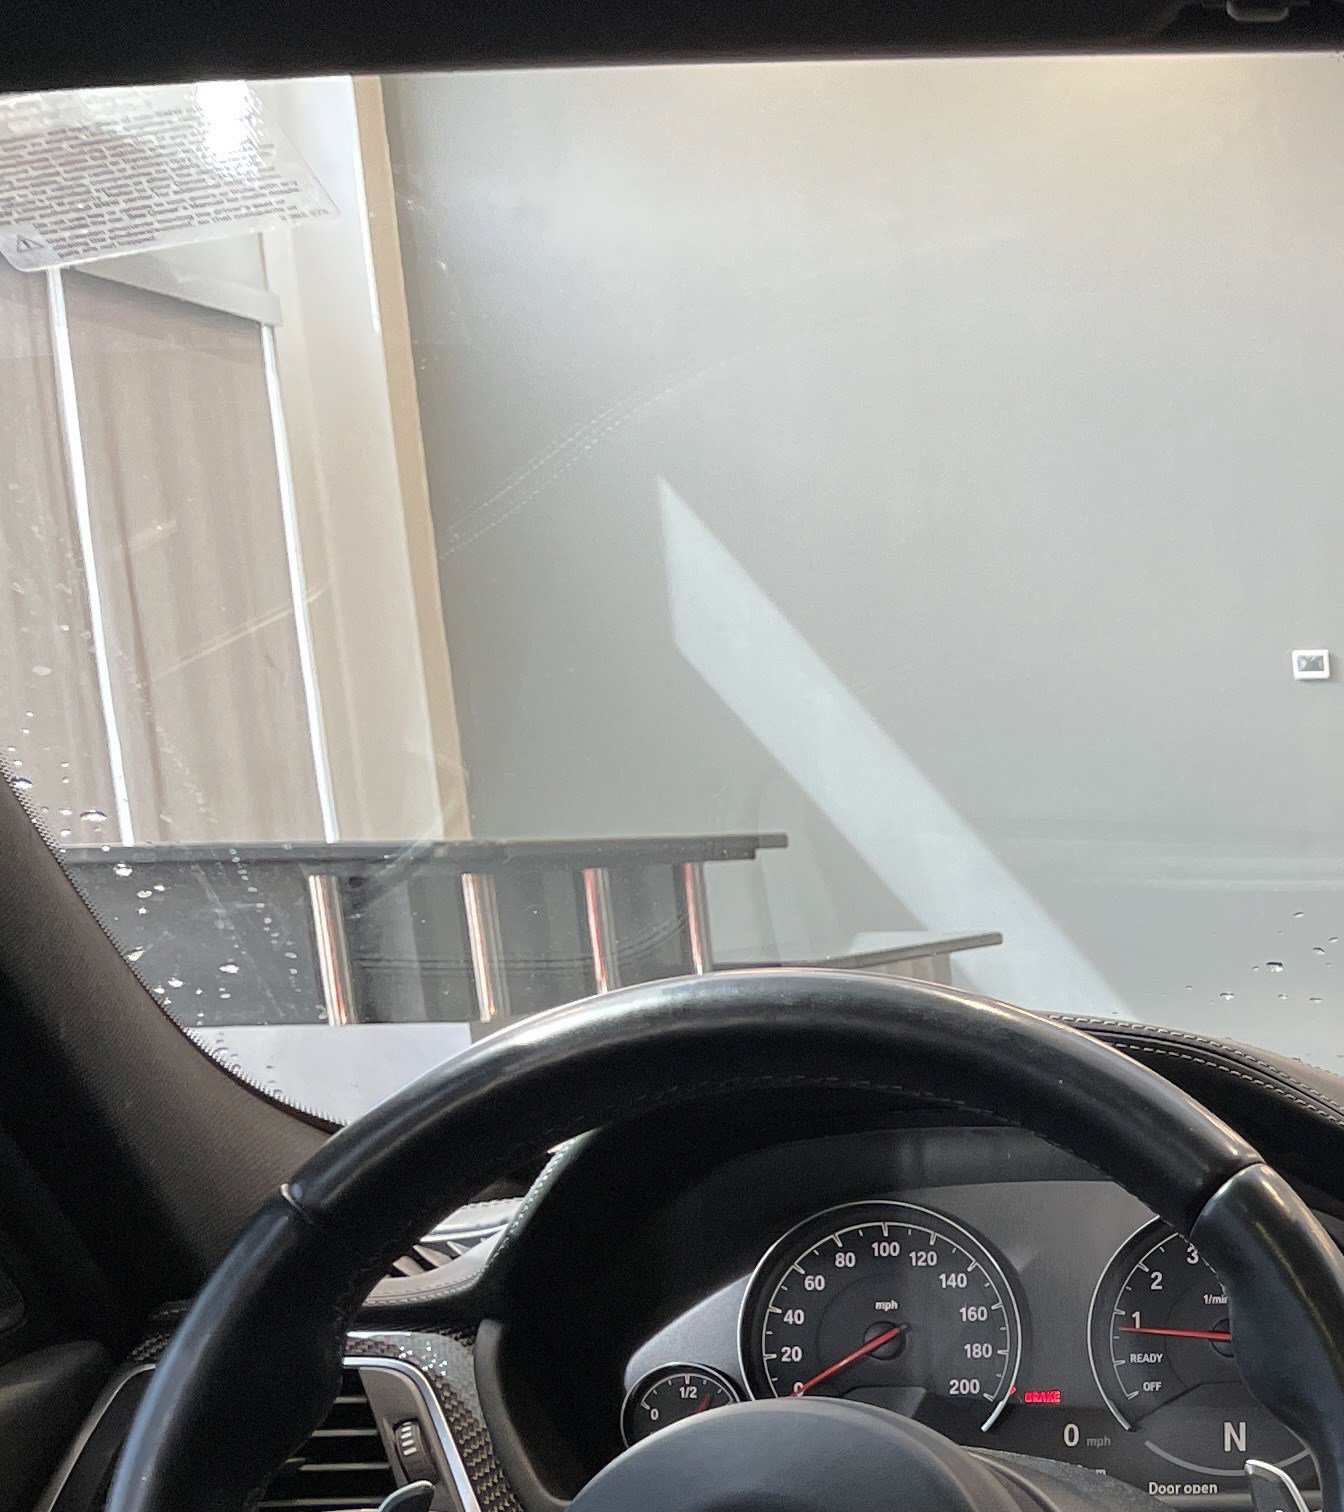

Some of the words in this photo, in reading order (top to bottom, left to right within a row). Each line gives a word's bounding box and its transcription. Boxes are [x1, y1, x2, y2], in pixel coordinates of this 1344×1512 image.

[871, 1241, 900, 1257] 100
[1187, 1244, 1199, 1264] 3
[834, 1252, 856, 1268] 80
[909, 1250, 938, 1267] 120
[804, 1275, 825, 1291] 60
[939, 1273, 968, 1289] 140
[1150, 1272, 1163, 1291] 2
[875, 1299, 898, 1312] mph
[783, 1309, 805, 1325] 40
[959, 1307, 988, 1322] 160
[1131, 1311, 1141, 1329] 1
[781, 1346, 802, 1362] 20
[964, 1343, 992, 1359] 180
[1129, 1352, 1163, 1364] READY
[679, 1386, 697, 1399] 1/2
[949, 1379, 980, 1395] 200
[1143, 1381, 1162, 1392] OFF
[1025, 1391, 1060, 1403] BRAKE
[650, 1408, 659, 1420] 0
[1064, 1423, 1079, 1447] 0
[1086, 1436, 1111, 1448] mph
[1223, 1422, 1247, 1452] N
[1148, 1481, 1180, 1495] Door
[1183, 1482, 1217, 1495] open
